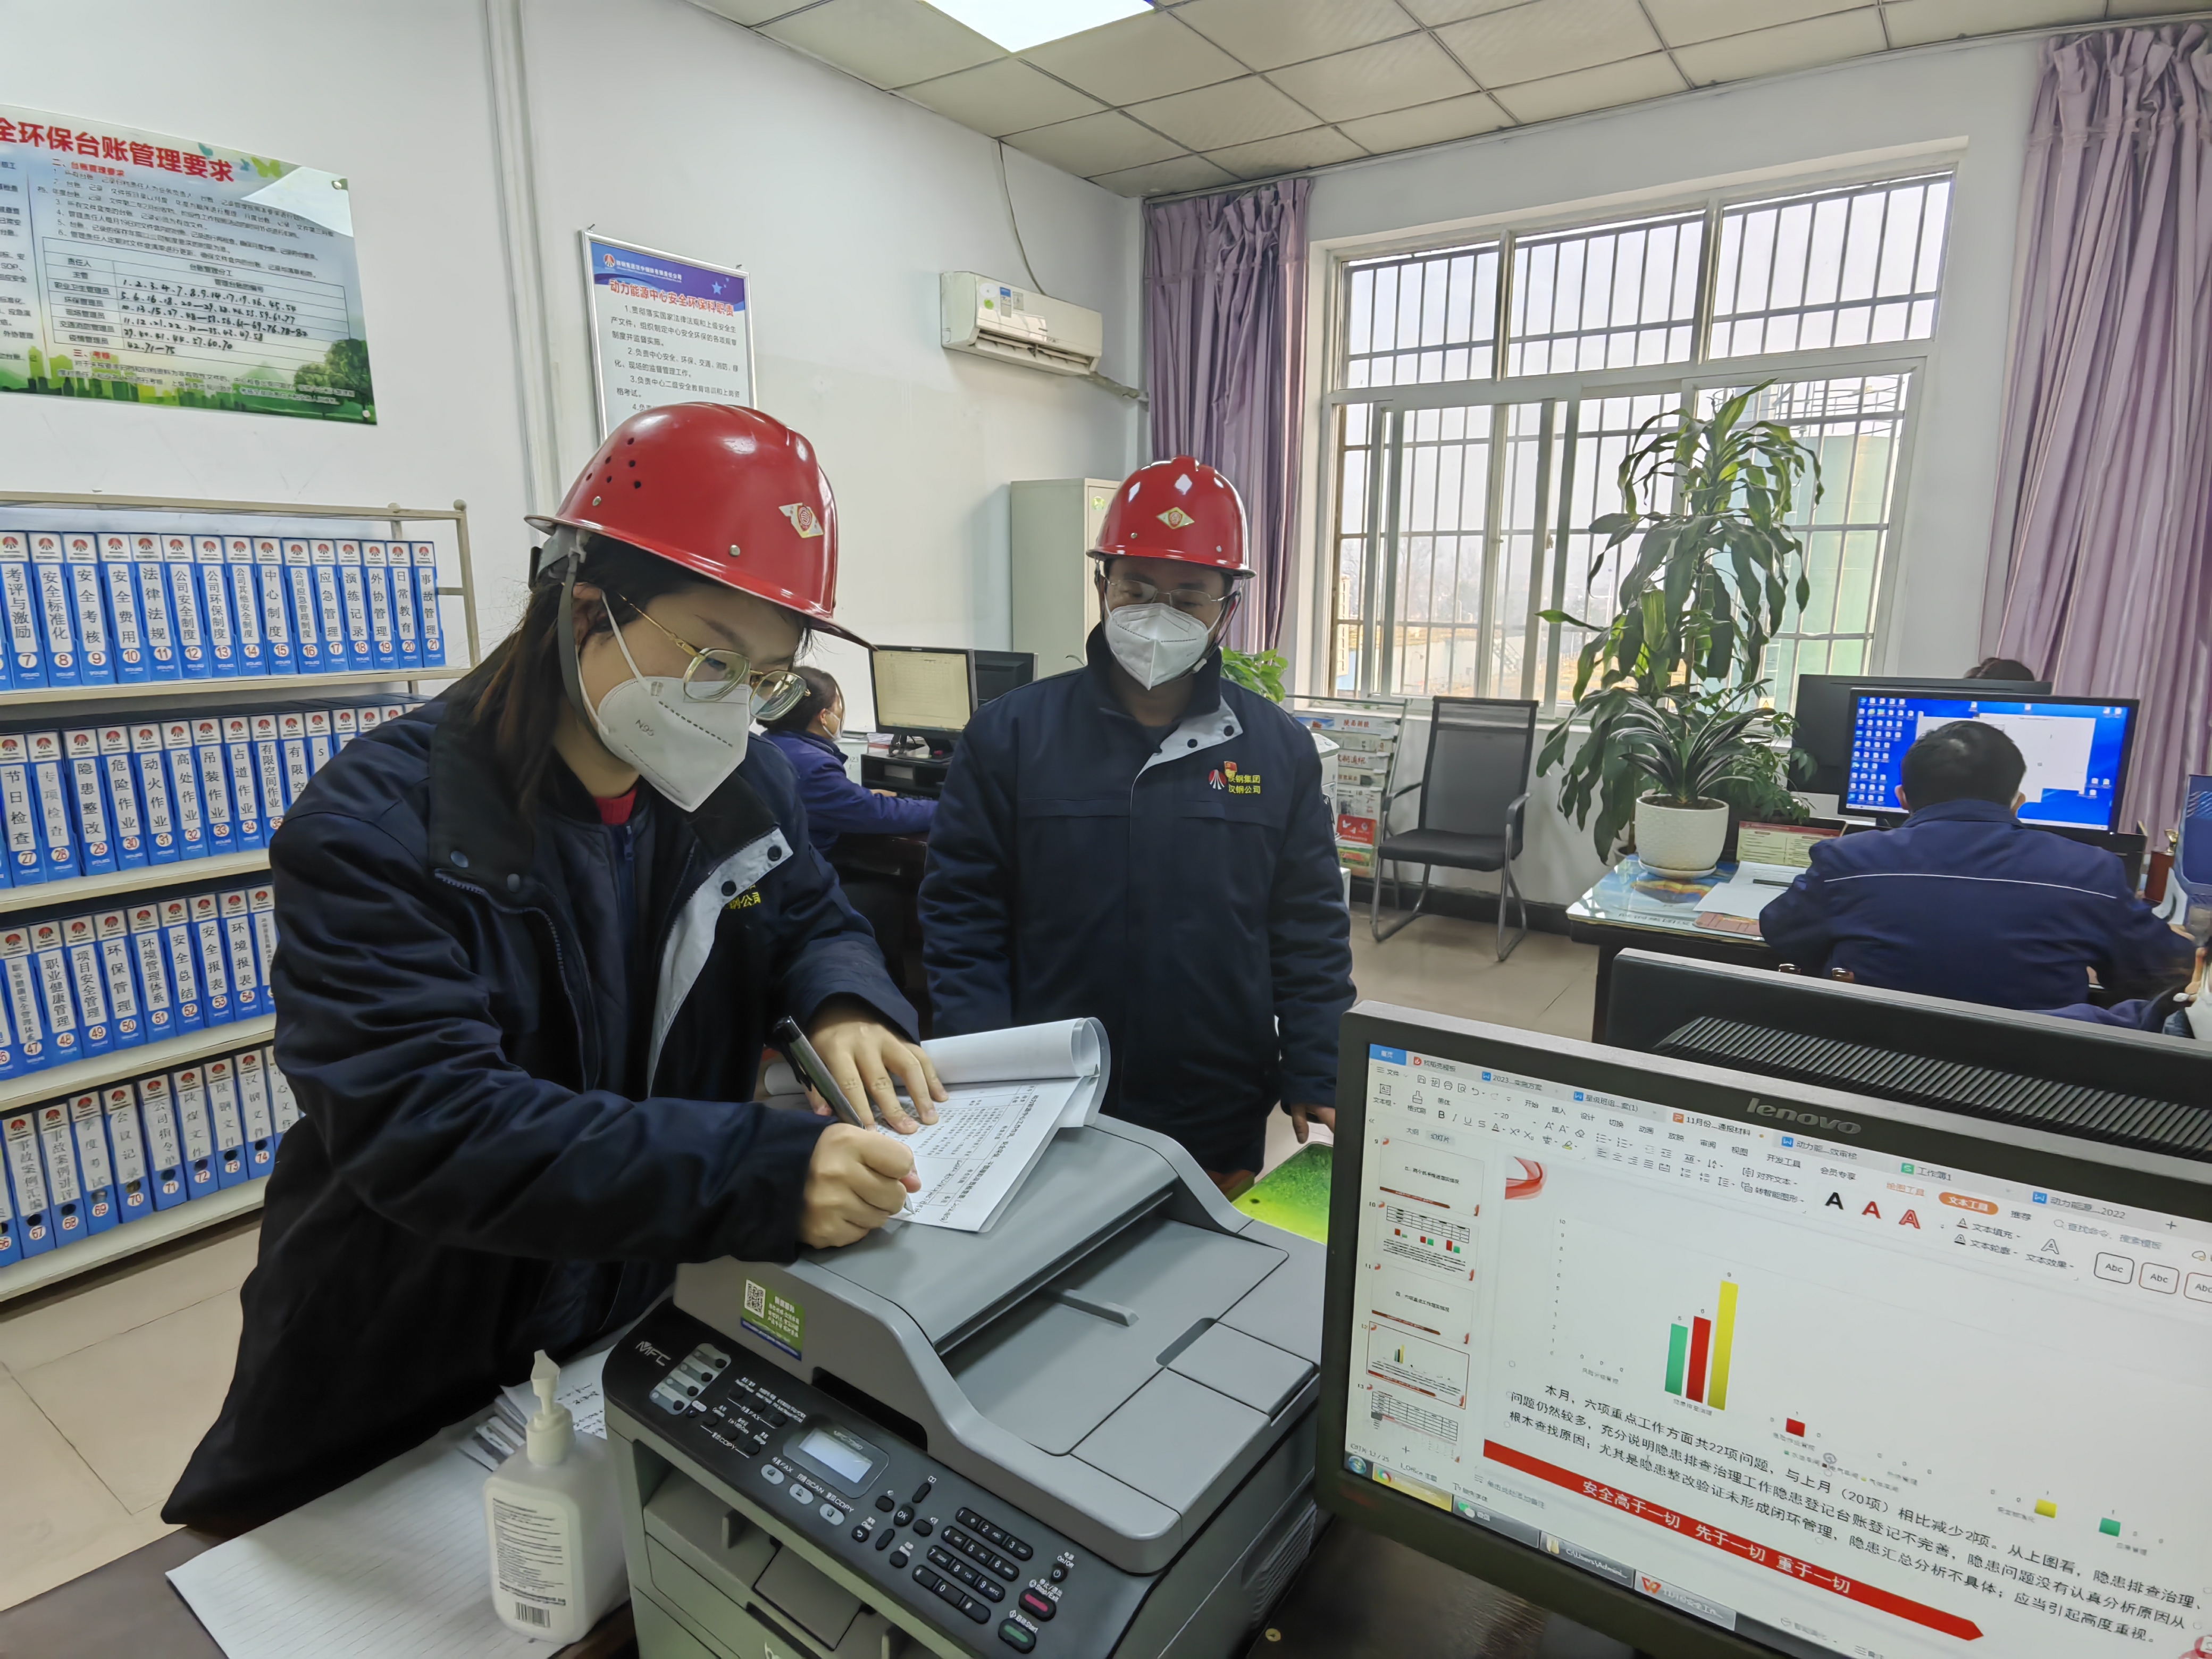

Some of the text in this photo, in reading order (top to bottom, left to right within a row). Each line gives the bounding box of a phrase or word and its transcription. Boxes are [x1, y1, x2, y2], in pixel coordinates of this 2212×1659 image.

[68, 258, 91, 267] 责任人
[609, 280, 734, 316] 动力能源中心安全环保科职责
[5, 568, 31, 639] 考评与激励
[42, 571, 69, 640] 安全标准化
[77, 569, 102, 644] 安全考核
[112, 570, 136, 643] 安全费用
[142, 567, 166, 640] 法律法规
[174, 570, 197, 641] 公司安全制度
[206, 570, 228, 640] 公司环保制度
[236, 567, 253, 638] 公司其他安全制度
[265, 570, 282, 638] 中心制度
[294, 570, 312, 638] 公司应急管理制度
[320, 572, 340, 638] 应急管理
[345, 572, 364, 637] 演练记录
[371, 573, 389, 637] 外协管理
[396, 571, 412, 634] 日常教育
[421, 574, 437, 635] 事故管理
[275, 645, 287, 656] 15
[330, 643, 341, 653] 17
[356, 642, 367, 652] 18
[381, 642, 391, 652] 19
[404, 642, 414, 651] 20
[429, 640, 438, 649] 21
[124, 650, 138, 661] 10
[156, 648, 169, 659] 11
[186, 648, 199, 659] 12
[216, 647, 229, 658] 13
[246, 646, 258, 656] 14
[304, 646, 316, 656] 16
[21, 655, 32, 666] 7
[59, 655, 68, 666] 8
[93, 652, 102, 665] 9
[635, 719, 654, 736] N95
[233, 748, 254, 814] 占道作业
[261, 744, 281, 808] 有限空间作业
[176, 753, 199, 822] 高处作业
[204, 751, 225, 819] 吊装作业
[1229, 784, 1261, 794] 汉钢公司
[77, 763, 102, 835] 隐患整改
[111, 759, 137, 830] 危险作业
[143, 759, 168, 828] 动火作业
[5, 770, 30, 845] 节日检查
[40, 772, 62, 837] 专项检查
[244, 822, 255, 832] 34
[272, 818, 283, 829] 35
[187, 830, 198, 840] 32
[215, 825, 228, 836] 33
[125, 838, 138, 849] 30
[158, 834, 170, 845] 31
[55, 849, 68, 860] 28
[93, 843, 105, 854] 29
[21, 853, 33, 864] 27
[202, 926, 224, 991] 安全报表
[231, 922, 252, 986] 环境报表
[141, 938, 164, 1003] 环境管理体系
[173, 934, 194, 999] 安全总结
[76, 950, 100, 1018] 项目安全管理
[106, 944, 131, 1012] 环保管理
[44, 958, 70, 1027] 职业健康管理
[241, 991, 253, 1002] 54
[214, 996, 225, 1007] 53
[183, 1004, 196, 1016] 52
[154, 1012, 166, 1023] 51
[121, 1020, 135, 1031] 50
[91, 1027, 104, 1038] 49
[59, 1034, 72, 1046] 48
[27, 1042, 38, 1054] 47
[1386, 1068, 1400, 1078] 文件
[1372, 1096, 1392, 1107] 文本框
[1746, 1096, 1862, 1135] lenovo
[1430, 1132, 1451, 1144] 幻灯片
[1524, 1099, 1539, 1109] 开始
[1551, 1105, 1566, 1116] 插入
[1580, 1111, 1596, 1121] 设计
[1608, 1118, 1624, 1129] 切换
[1638, 1125, 1654, 1135] 动画
[1668, 1132, 1685, 1142] 放映
[1700, 1138, 1716, 1149] 审阅
[1731, 1146, 1748, 1157] 视图
[1766, 1153, 1802, 1169] 开发工具
[1820, 1166, 1857, 1181] 会员专享
[1948, 1196, 1989, 1212] 文本工具
[227, 1162, 239, 1172] 73
[197, 1171, 209, 1182] 72
[1756, 1171, 1791, 1186] 对齐文本
[164, 1182, 176, 1193] 71
[129, 1194, 143, 1205] 70
[1755, 1186, 1798, 1203] 转智能图形
[31, 1226, 44, 1238] 67
[1972, 1224, 2013, 1239] 文本填充
[1969, 1239, 2011, 1255] 文本轮廓
[2025, 1254, 2067, 1269] 文本效果
[2105, 1263, 2124, 1273] Abc
[2150, 1273, 2168, 1283] Abc
[635, 1340, 671, 1367] MFC
[897, 1511, 908, 1520] OK
[1583, 1480, 1851, 1594] 安全高于一切 先于一切 重于一切
[1057, 1554, 1075, 1569] On/Off
